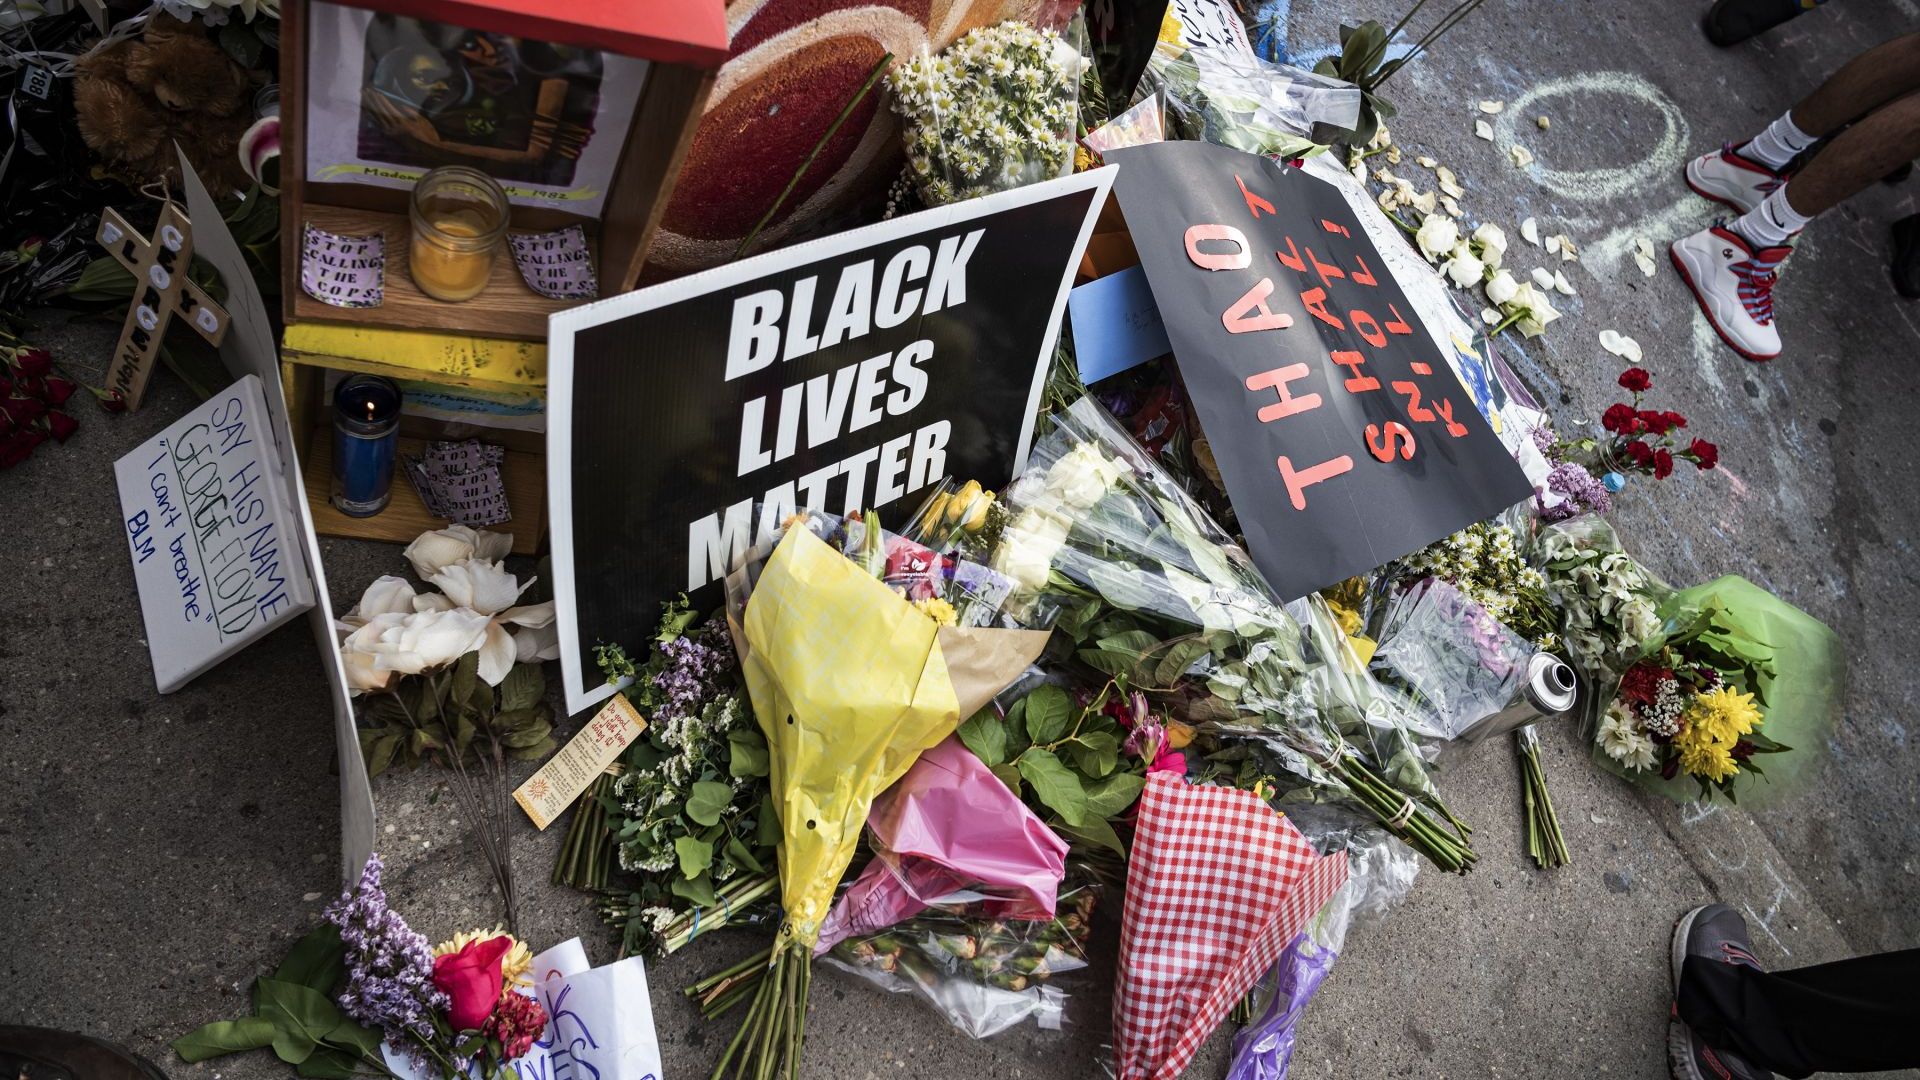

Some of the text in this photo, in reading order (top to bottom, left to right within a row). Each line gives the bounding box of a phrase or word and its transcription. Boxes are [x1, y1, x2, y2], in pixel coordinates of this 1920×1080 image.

[29, 70, 48, 95] 188
[310, 235, 369, 255] STOP
[517, 238, 568, 252] STOP
[520, 249, 583, 265] CALLING
[309, 249, 379, 270] CALLING
[319, 267, 358, 284] THE
[533, 267, 568, 278] THE
[724, 228, 985, 382] BLACK
[1234, 173, 1416, 464] SHALT
[1305, 245, 1438, 423] NOT
[1183, 223, 1354, 511] THAO
[737, 339, 935, 478] LIVES
[149, 472, 182, 529] can't
[451, 494, 501, 510] CALLING
[462, 484, 491, 498] THE
[211, 397, 290, 622] SAY HIS NAME
[463, 506, 504, 521] STOP
[127, 509, 156, 564] BLM
[174, 423, 258, 635] GEORGE FLOYD
